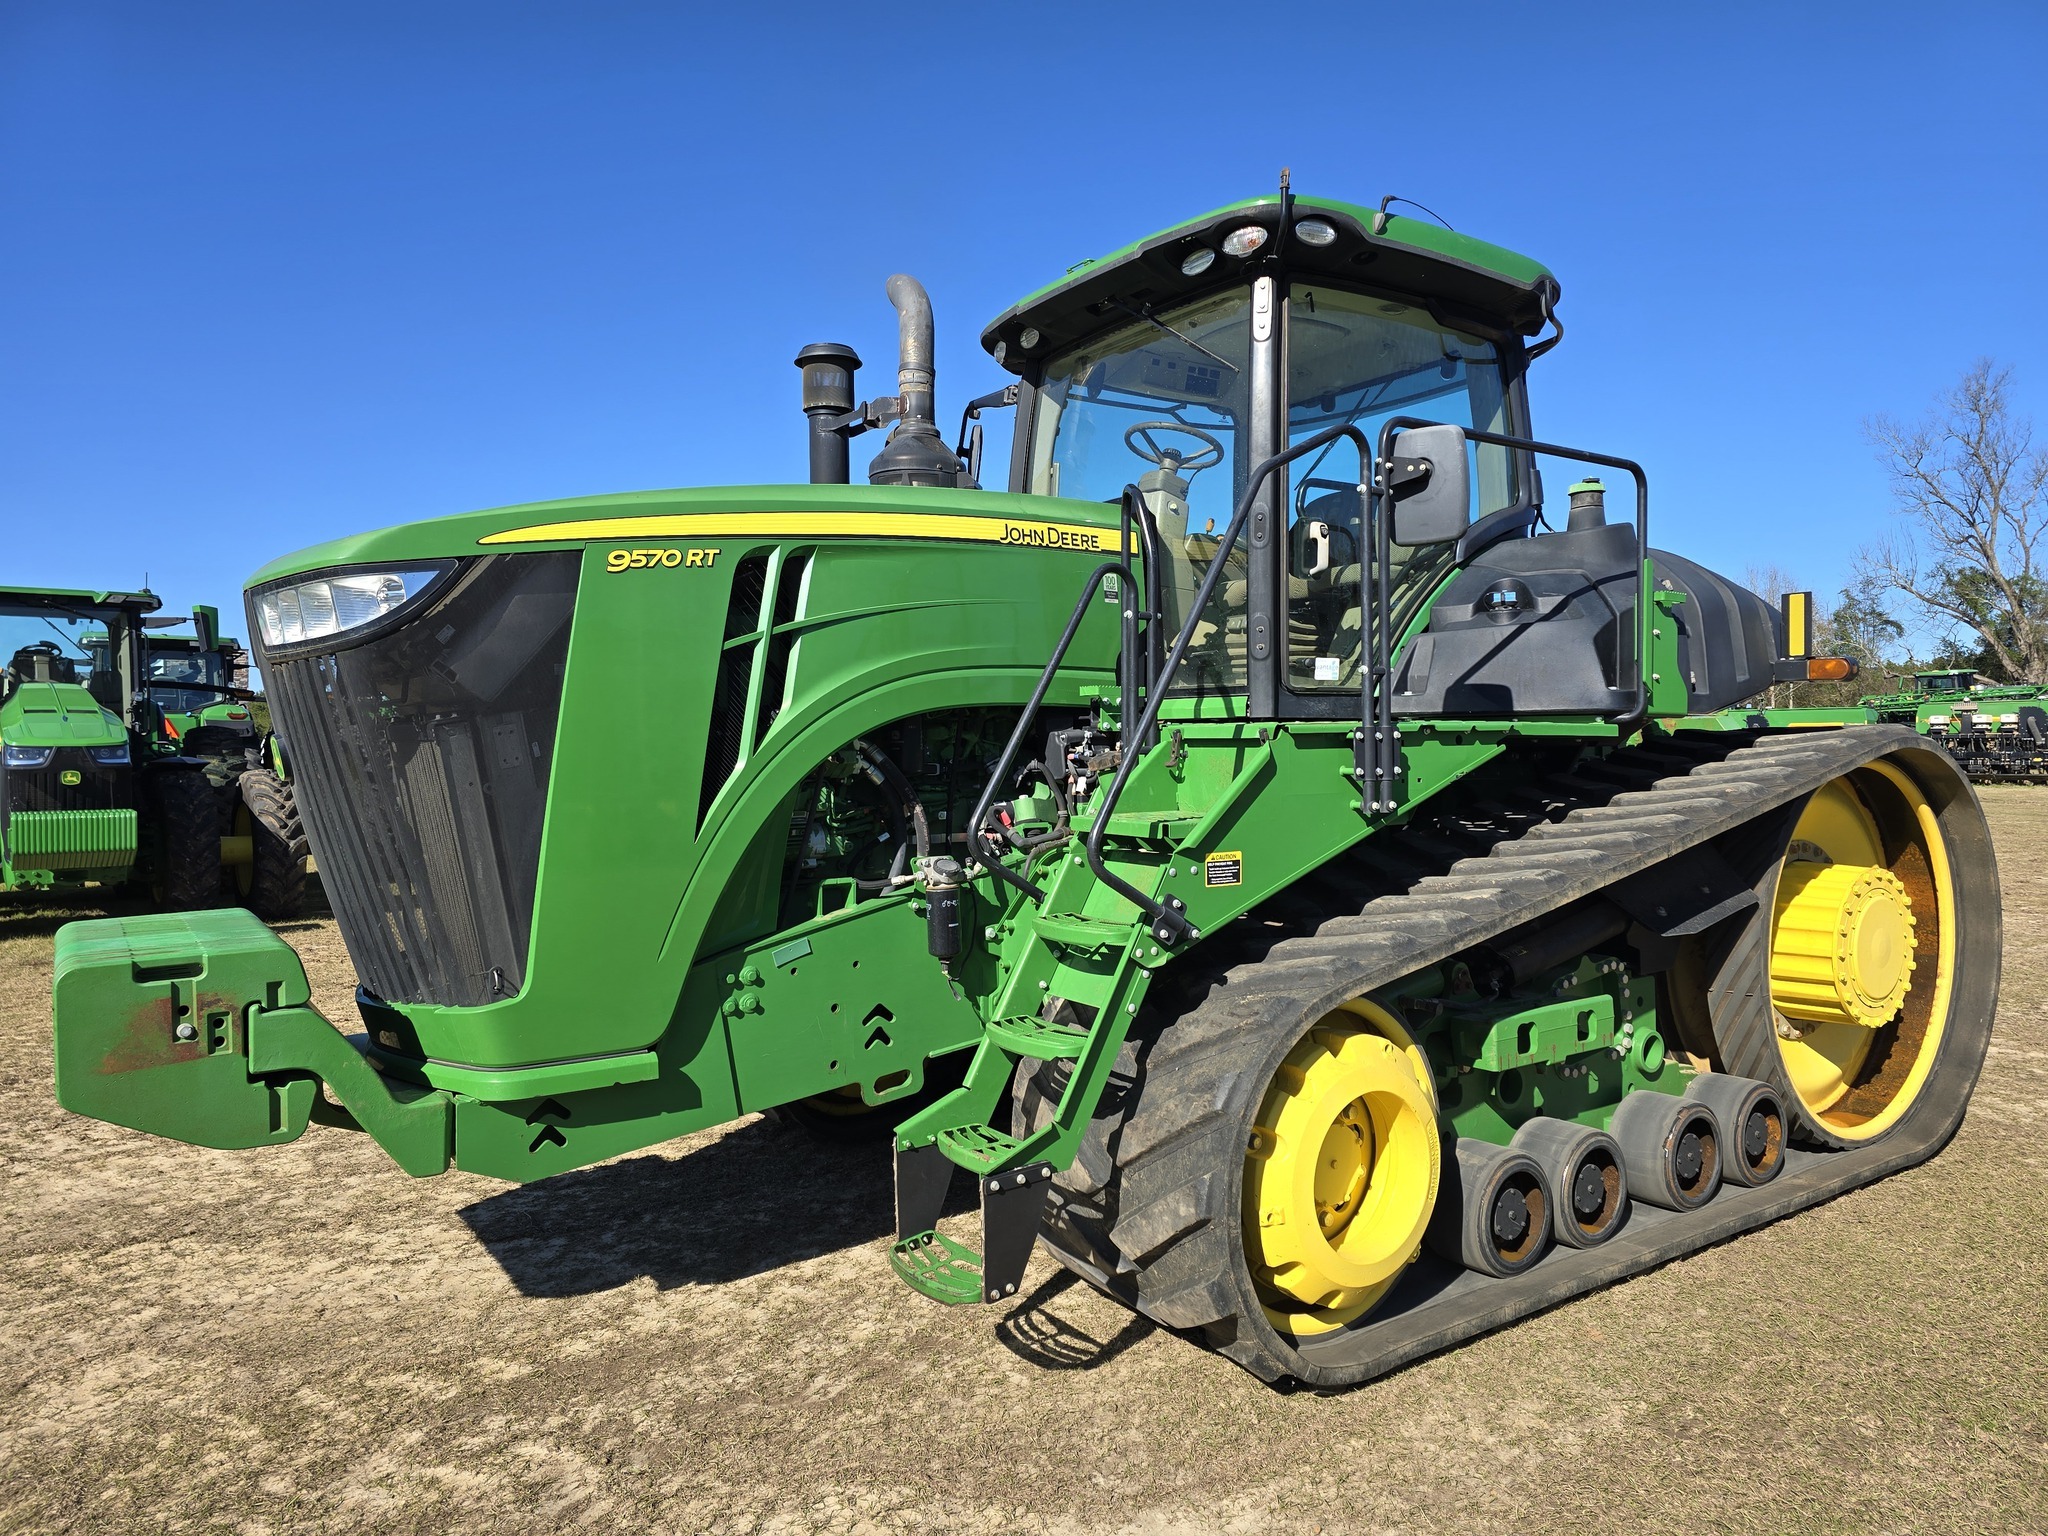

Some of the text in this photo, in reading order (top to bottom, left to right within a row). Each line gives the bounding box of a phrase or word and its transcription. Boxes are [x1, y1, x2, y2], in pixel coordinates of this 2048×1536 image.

[1000, 523, 1100, 549] JOHN DEERE
[606, 548, 721, 573] 9570 RT
